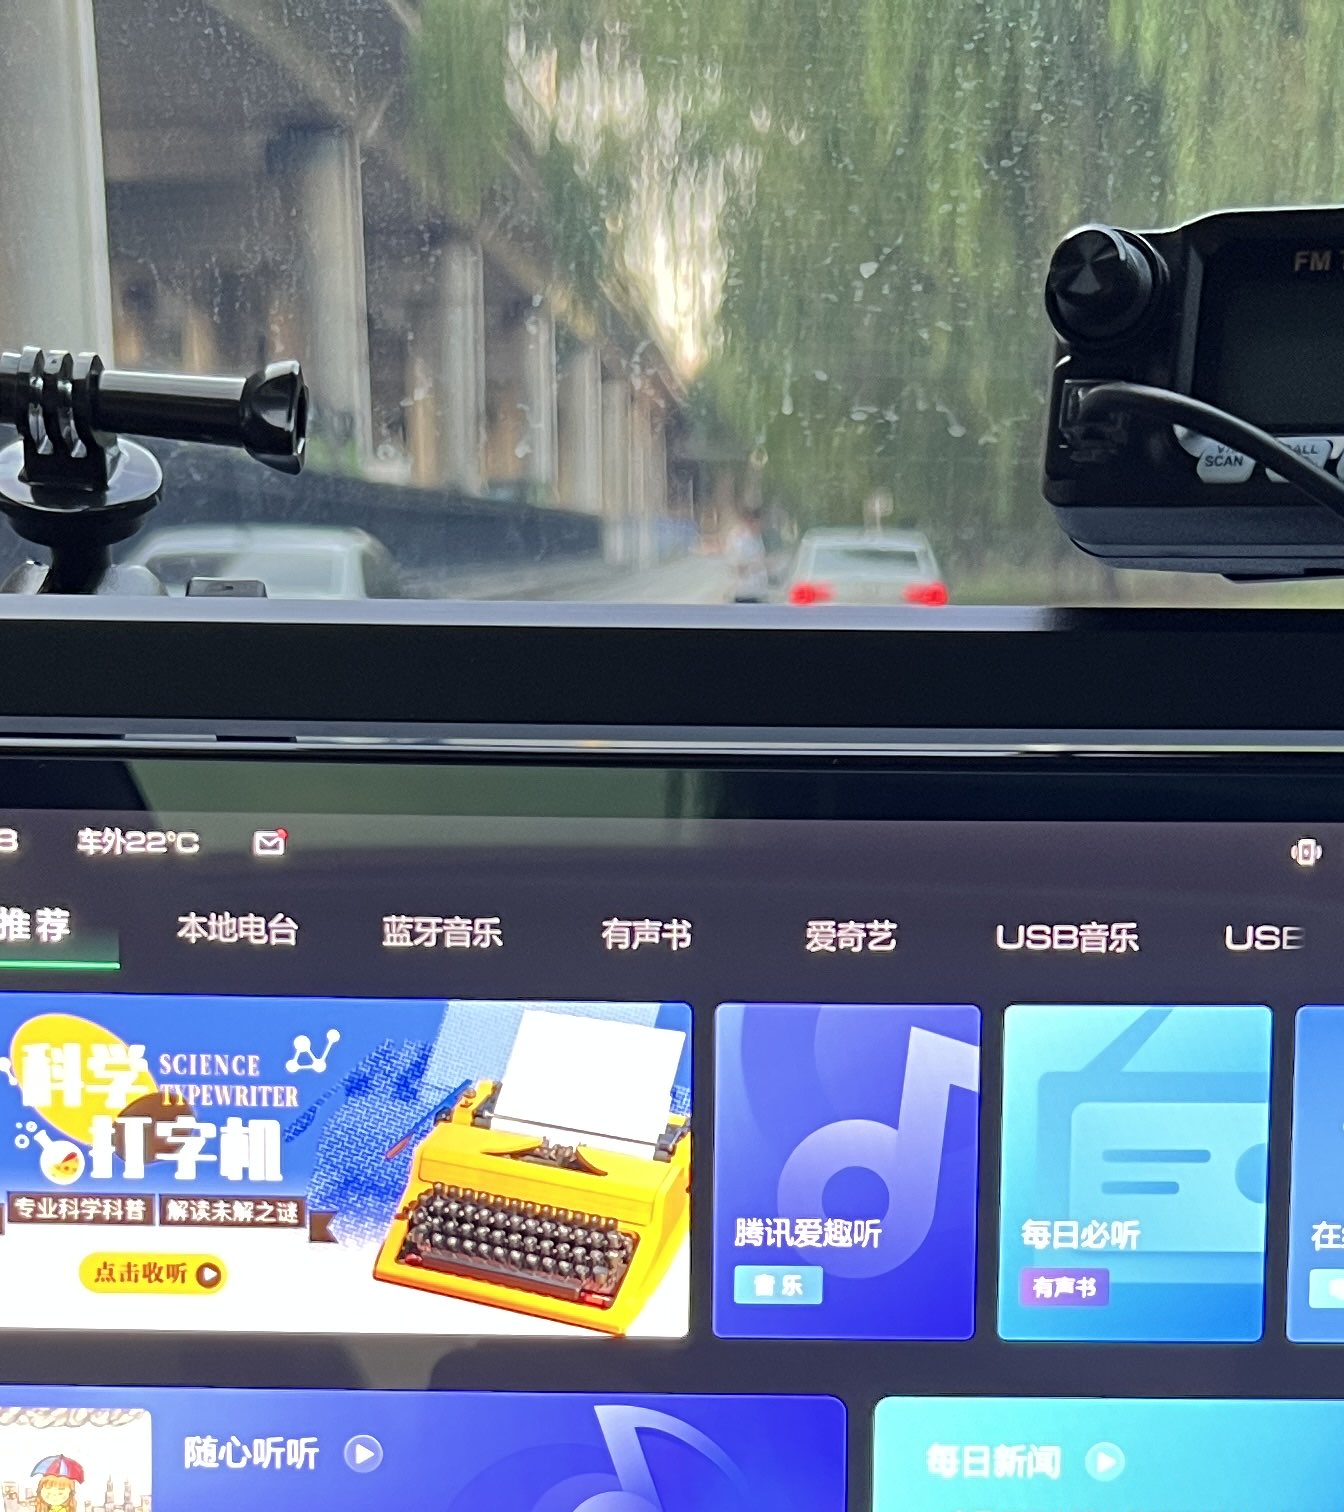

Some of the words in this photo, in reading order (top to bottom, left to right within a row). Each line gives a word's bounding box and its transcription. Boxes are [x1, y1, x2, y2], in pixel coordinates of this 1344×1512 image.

[1293, 251, 1331, 272] FM
[1205, 455, 1244, 468] SCAN
[176, 912, 299, 948] 本地电台
[381, 915, 504, 950] 蓝牙音乐
[601, 918, 693, 952] 有声书
[805, 919, 898, 954] 爱奇艺
[995, 921, 1140, 954] USB音乐
[22, 1042, 150, 1109] 科学
[159, 1053, 261, 1077] SCIENCE
[158, 1083, 300, 1108] TYPEWRITER
[88, 1114, 284, 1182] 打字机
[14, 1197, 147, 1221] 专业科学科普
[165, 1199, 300, 1223] 解读未解之谜
[734, 1217, 883, 1249] 腾讯爱趣听
[1020, 1218, 1142, 1252] 每日必听
[92, 1260, 189, 1286] 点击收听
[1032, 1275, 1098, 1299] 有声书
[182, 1435, 320, 1470] 随心听听
[926, 1443, 1062, 1480] 每日新闻
